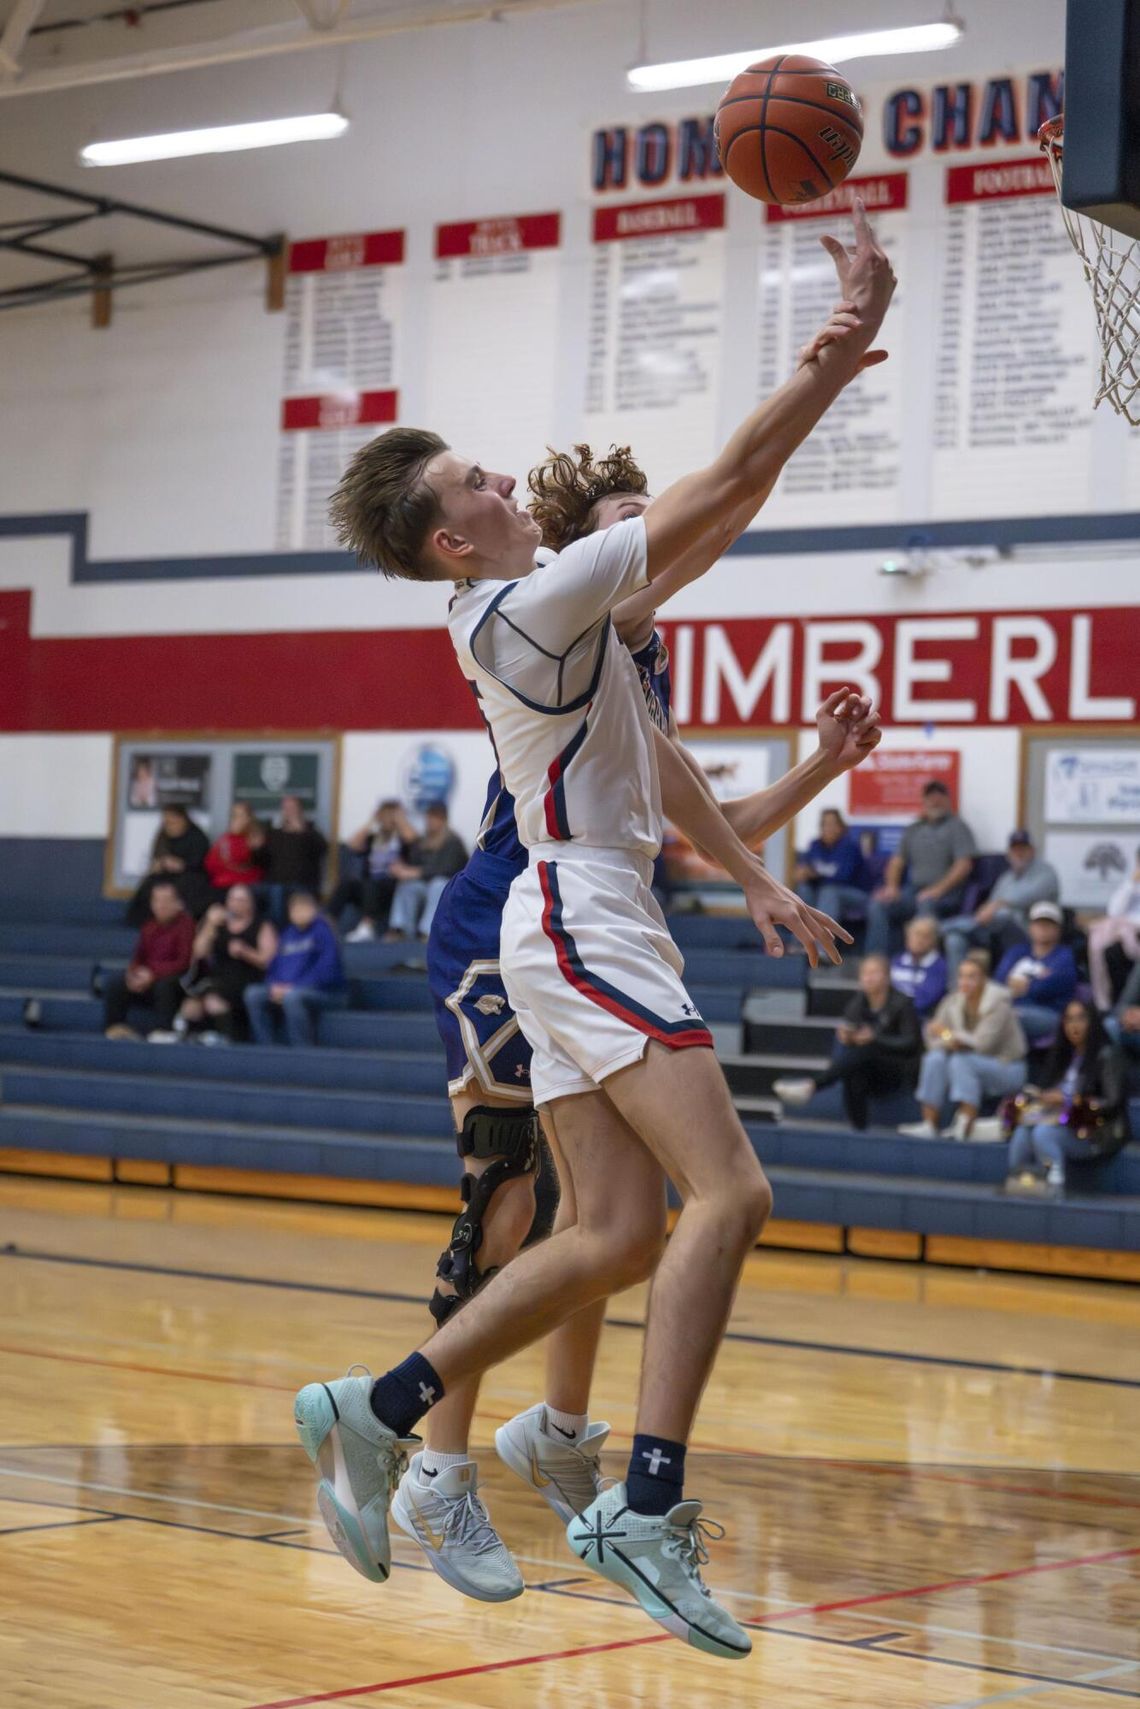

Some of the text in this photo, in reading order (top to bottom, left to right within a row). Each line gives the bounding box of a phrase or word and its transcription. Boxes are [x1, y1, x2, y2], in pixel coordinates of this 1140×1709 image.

[592, 117, 723, 192] HOM
[883, 70, 1065, 158] CHAM
[655, 613, 1137, 725] IMBERL
